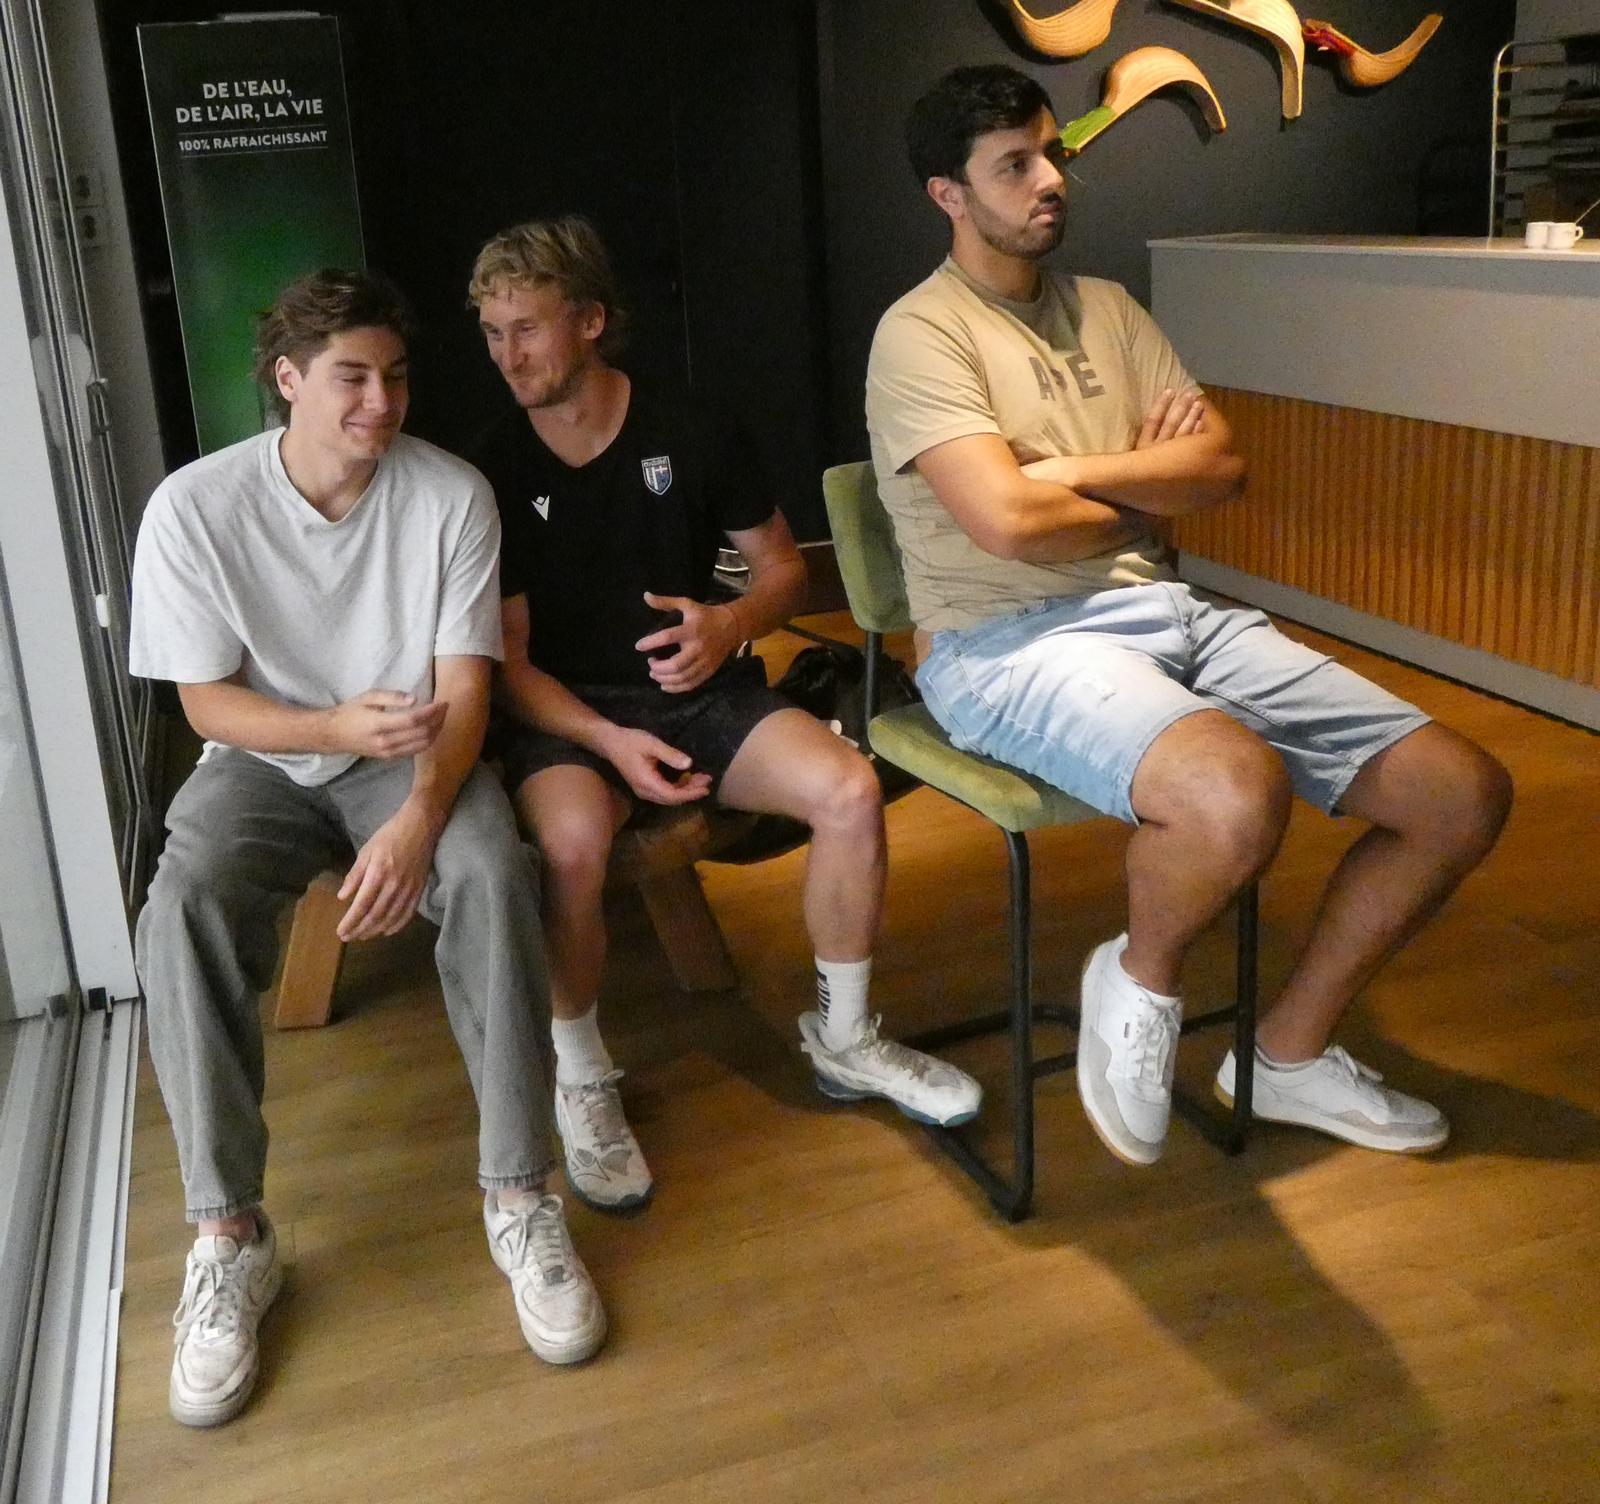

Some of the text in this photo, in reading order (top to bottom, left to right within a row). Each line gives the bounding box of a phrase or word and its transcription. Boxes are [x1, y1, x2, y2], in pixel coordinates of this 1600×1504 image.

[203, 79, 292, 99] DE L'EAU,
[176, 99, 323, 123] DE L'AIR, LA VIE
[178, 130, 328, 151] 100% RAFRAICHISSANT
[1028, 352, 1106, 401] AE
